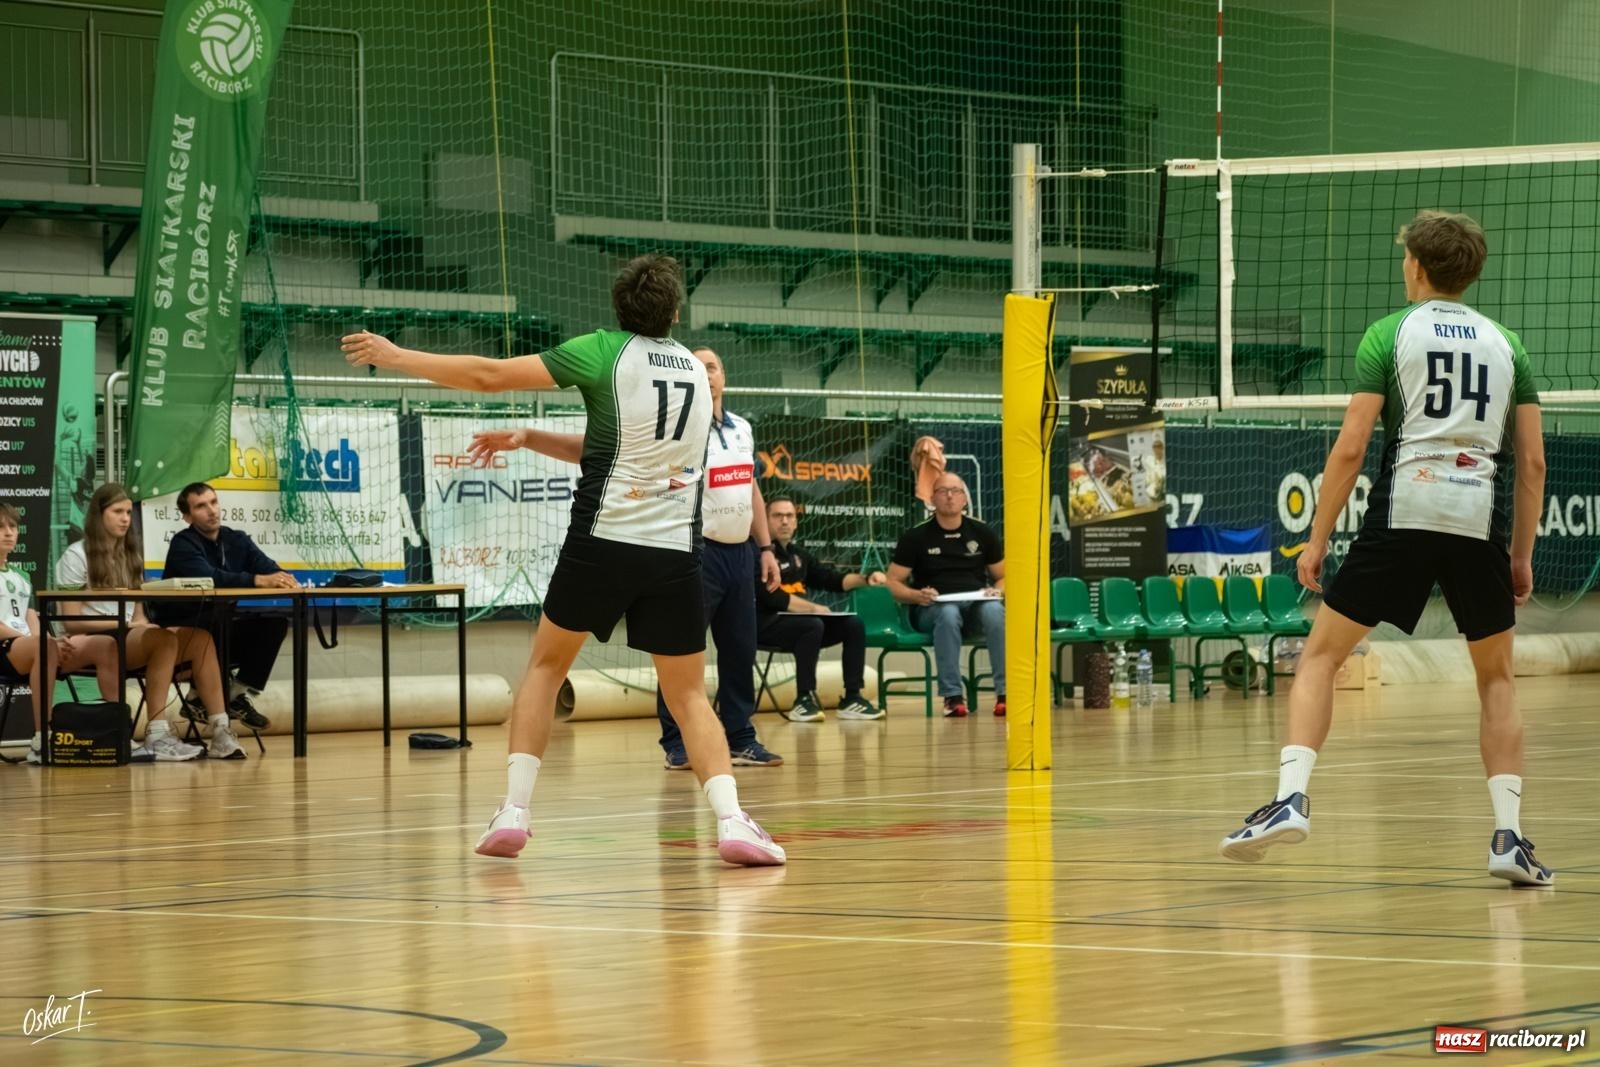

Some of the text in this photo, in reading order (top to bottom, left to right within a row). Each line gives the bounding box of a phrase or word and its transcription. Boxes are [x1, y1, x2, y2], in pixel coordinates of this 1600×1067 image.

[186, 1, 216, 35] KLUB
[141, 113, 196, 407] KLUB SIATKARSKI
[182, 180, 217, 350] RACIBÓRZ
[1433, 323, 1477, 340] RZYTKI
[647, 351, 694, 371] KOZIELEC
[1096, 378, 1148, 395] SZYPUŁA
[1423, 351, 1491, 422] 54
[652, 379, 695, 441] 17
[11, 440, 25, 451] U17
[713, 469, 752, 483] martes
[796, 461, 872, 481] SPAWX
[435, 477, 580, 504] VANES
[154, 506, 171, 520] tel.
[252, 509, 271, 522] 502
[1536, 494, 1600, 537] ACI
[374, 533, 381, 545] 2
[11, 598, 20, 617] 6
[55, 732, 75, 746] 3D
